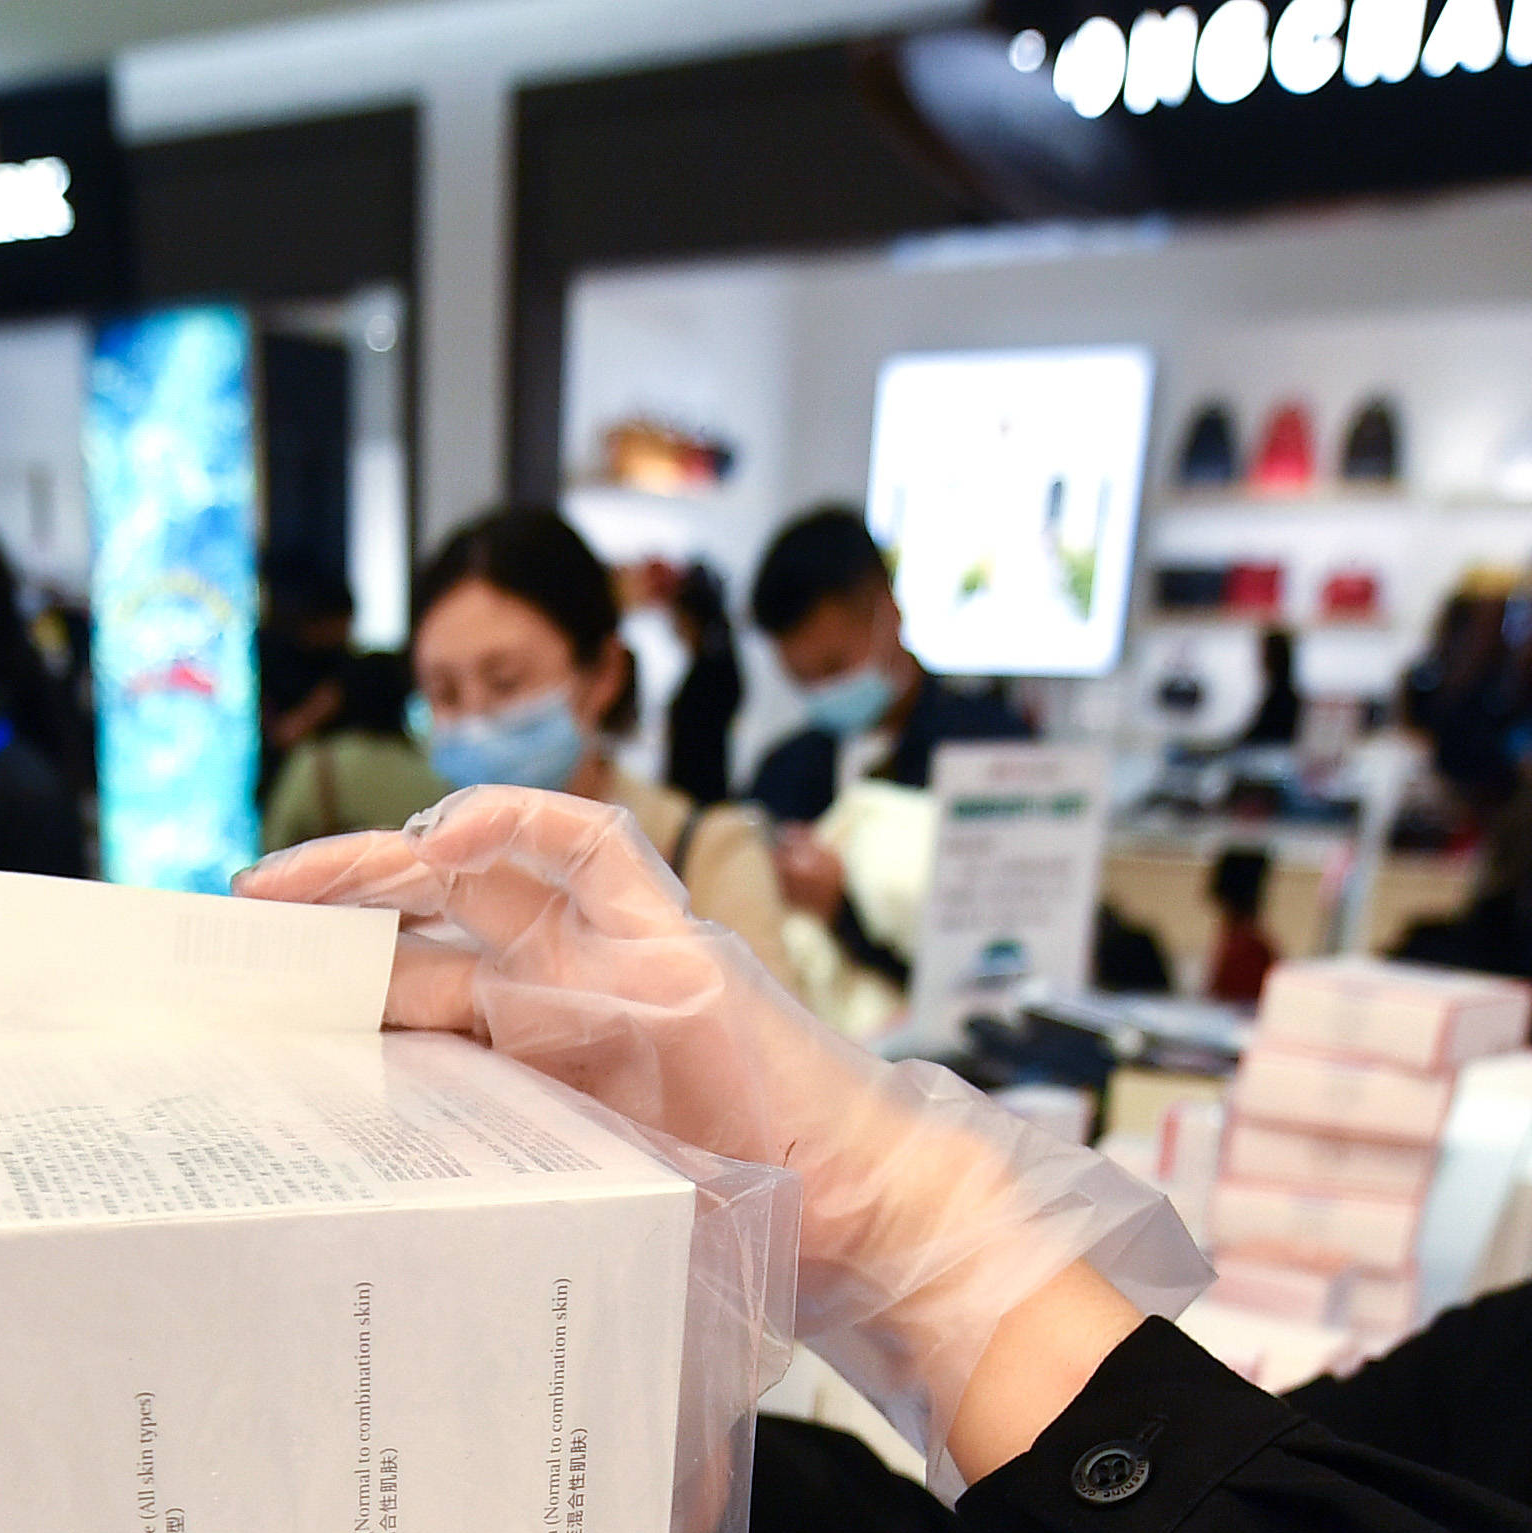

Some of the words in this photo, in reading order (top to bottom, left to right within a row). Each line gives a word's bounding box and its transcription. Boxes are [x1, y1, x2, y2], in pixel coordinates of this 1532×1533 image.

[354, 1282, 374, 1325] skin)
[551, 1278, 570, 1321] skin)
[353, 1331, 371, 1441] combination
[547, 1326, 566, 1433] combination
[134, 1391, 157, 1444] types)
[136, 1450, 155, 1484] skin
[356, 1447, 370, 1463] to
[548, 1437, 562, 1454] to
[138, 1490, 157, 1519] (All
[544, 1459, 563, 1525] (Normal
